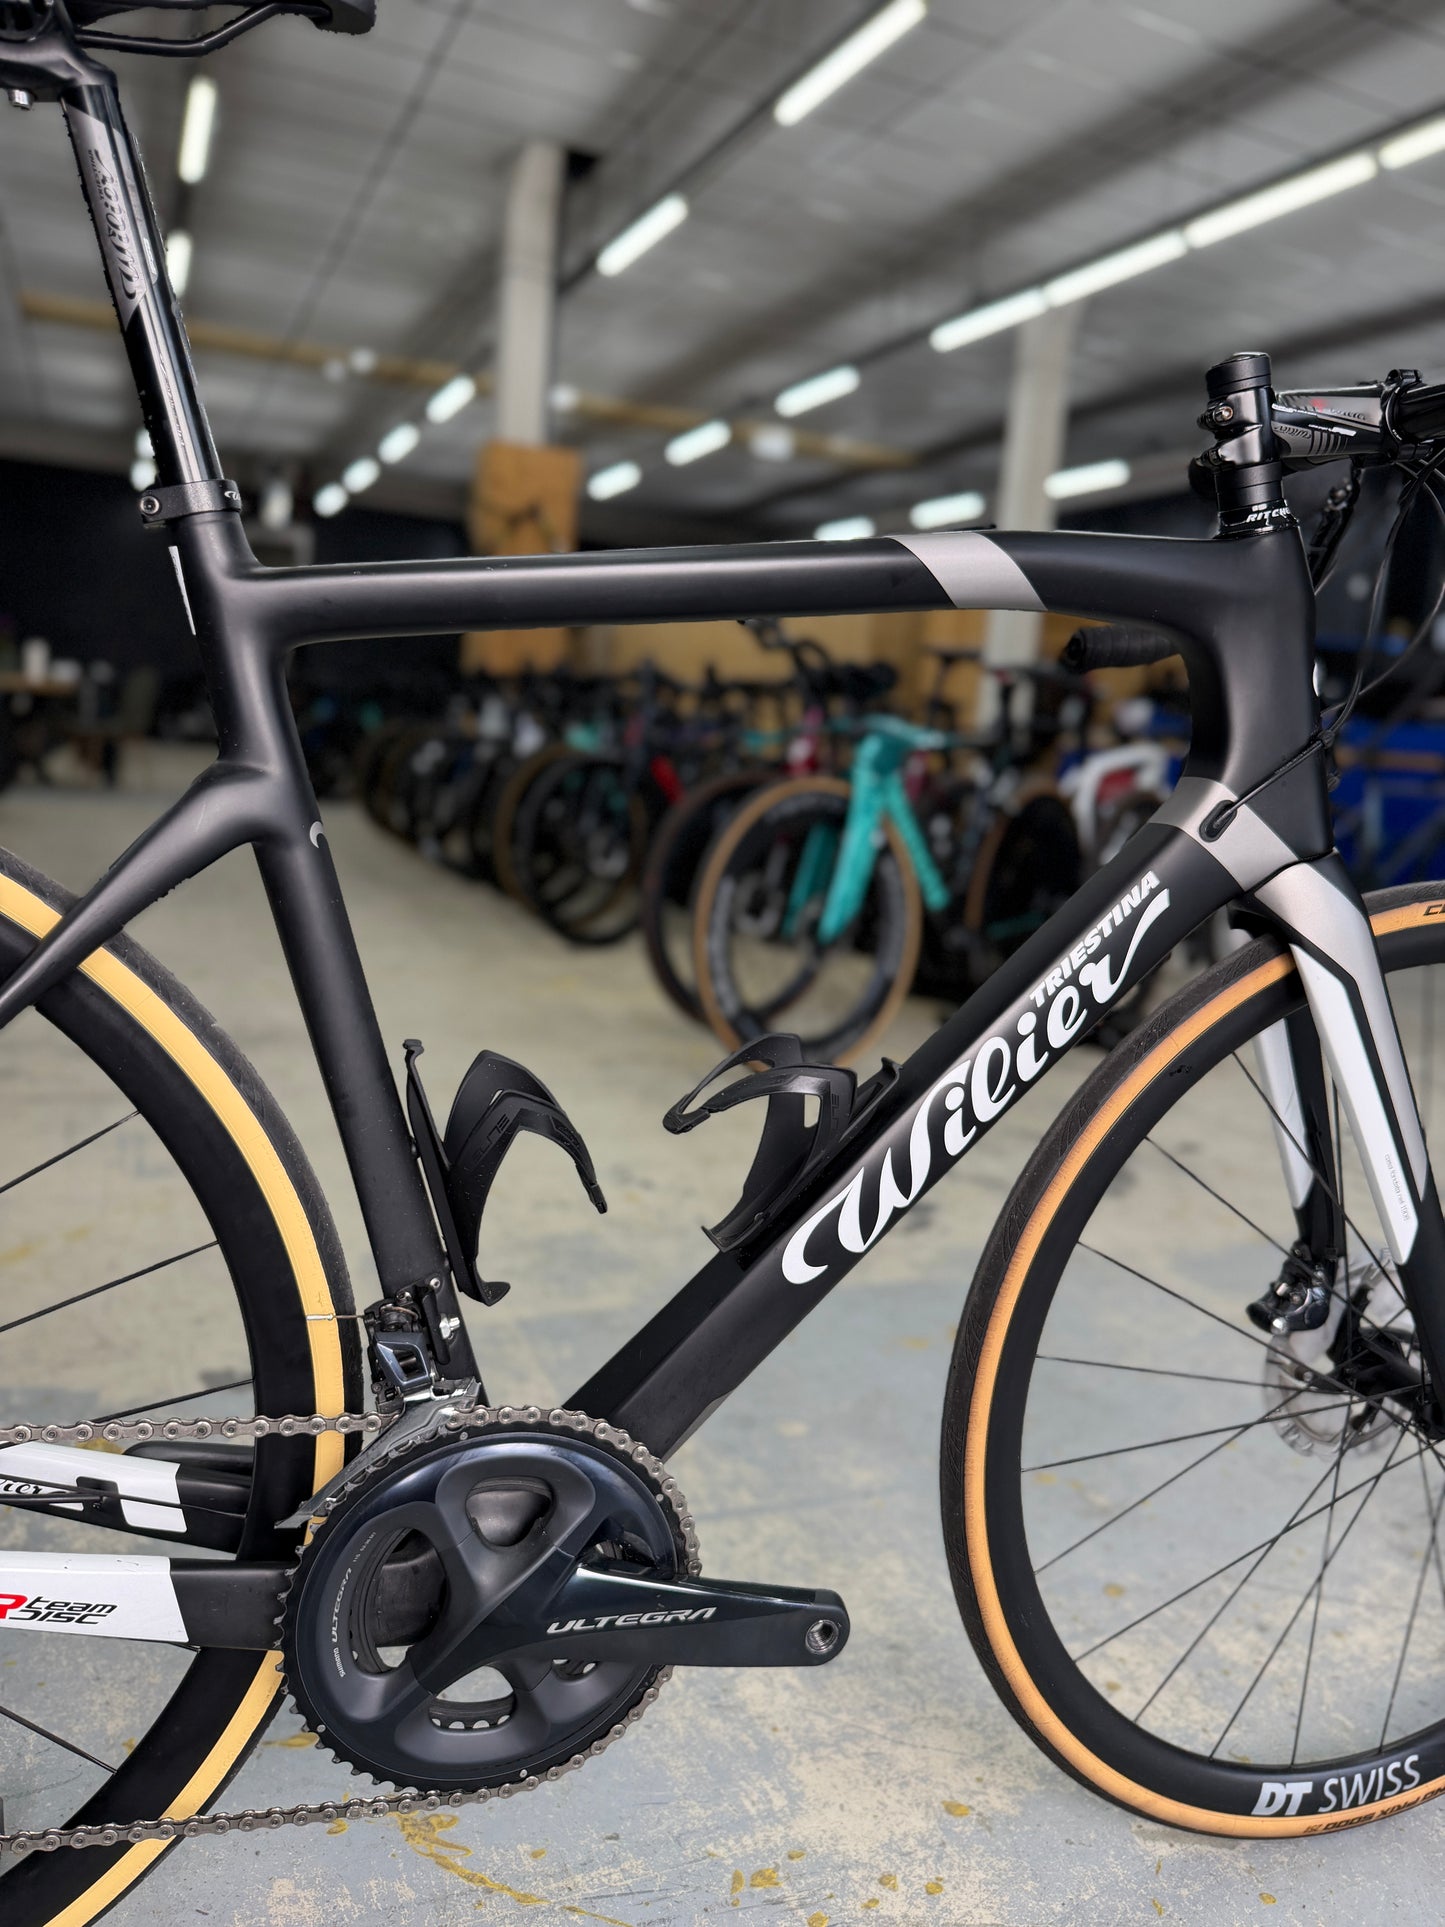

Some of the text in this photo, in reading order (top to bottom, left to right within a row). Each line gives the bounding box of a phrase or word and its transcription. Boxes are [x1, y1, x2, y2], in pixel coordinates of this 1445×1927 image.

[1030, 870, 1161, 1008] TRIESTINA
[782, 888, 1170, 1285] Wilier
[9, 1609, 107, 1624] DISC
[25, 1596, 118, 1613] team
[331, 1567, 352, 1643] ULTEGRA
[546, 1606, 717, 1635] ULTEGRA
[1251, 1754, 1420, 1816] DT SWISS
